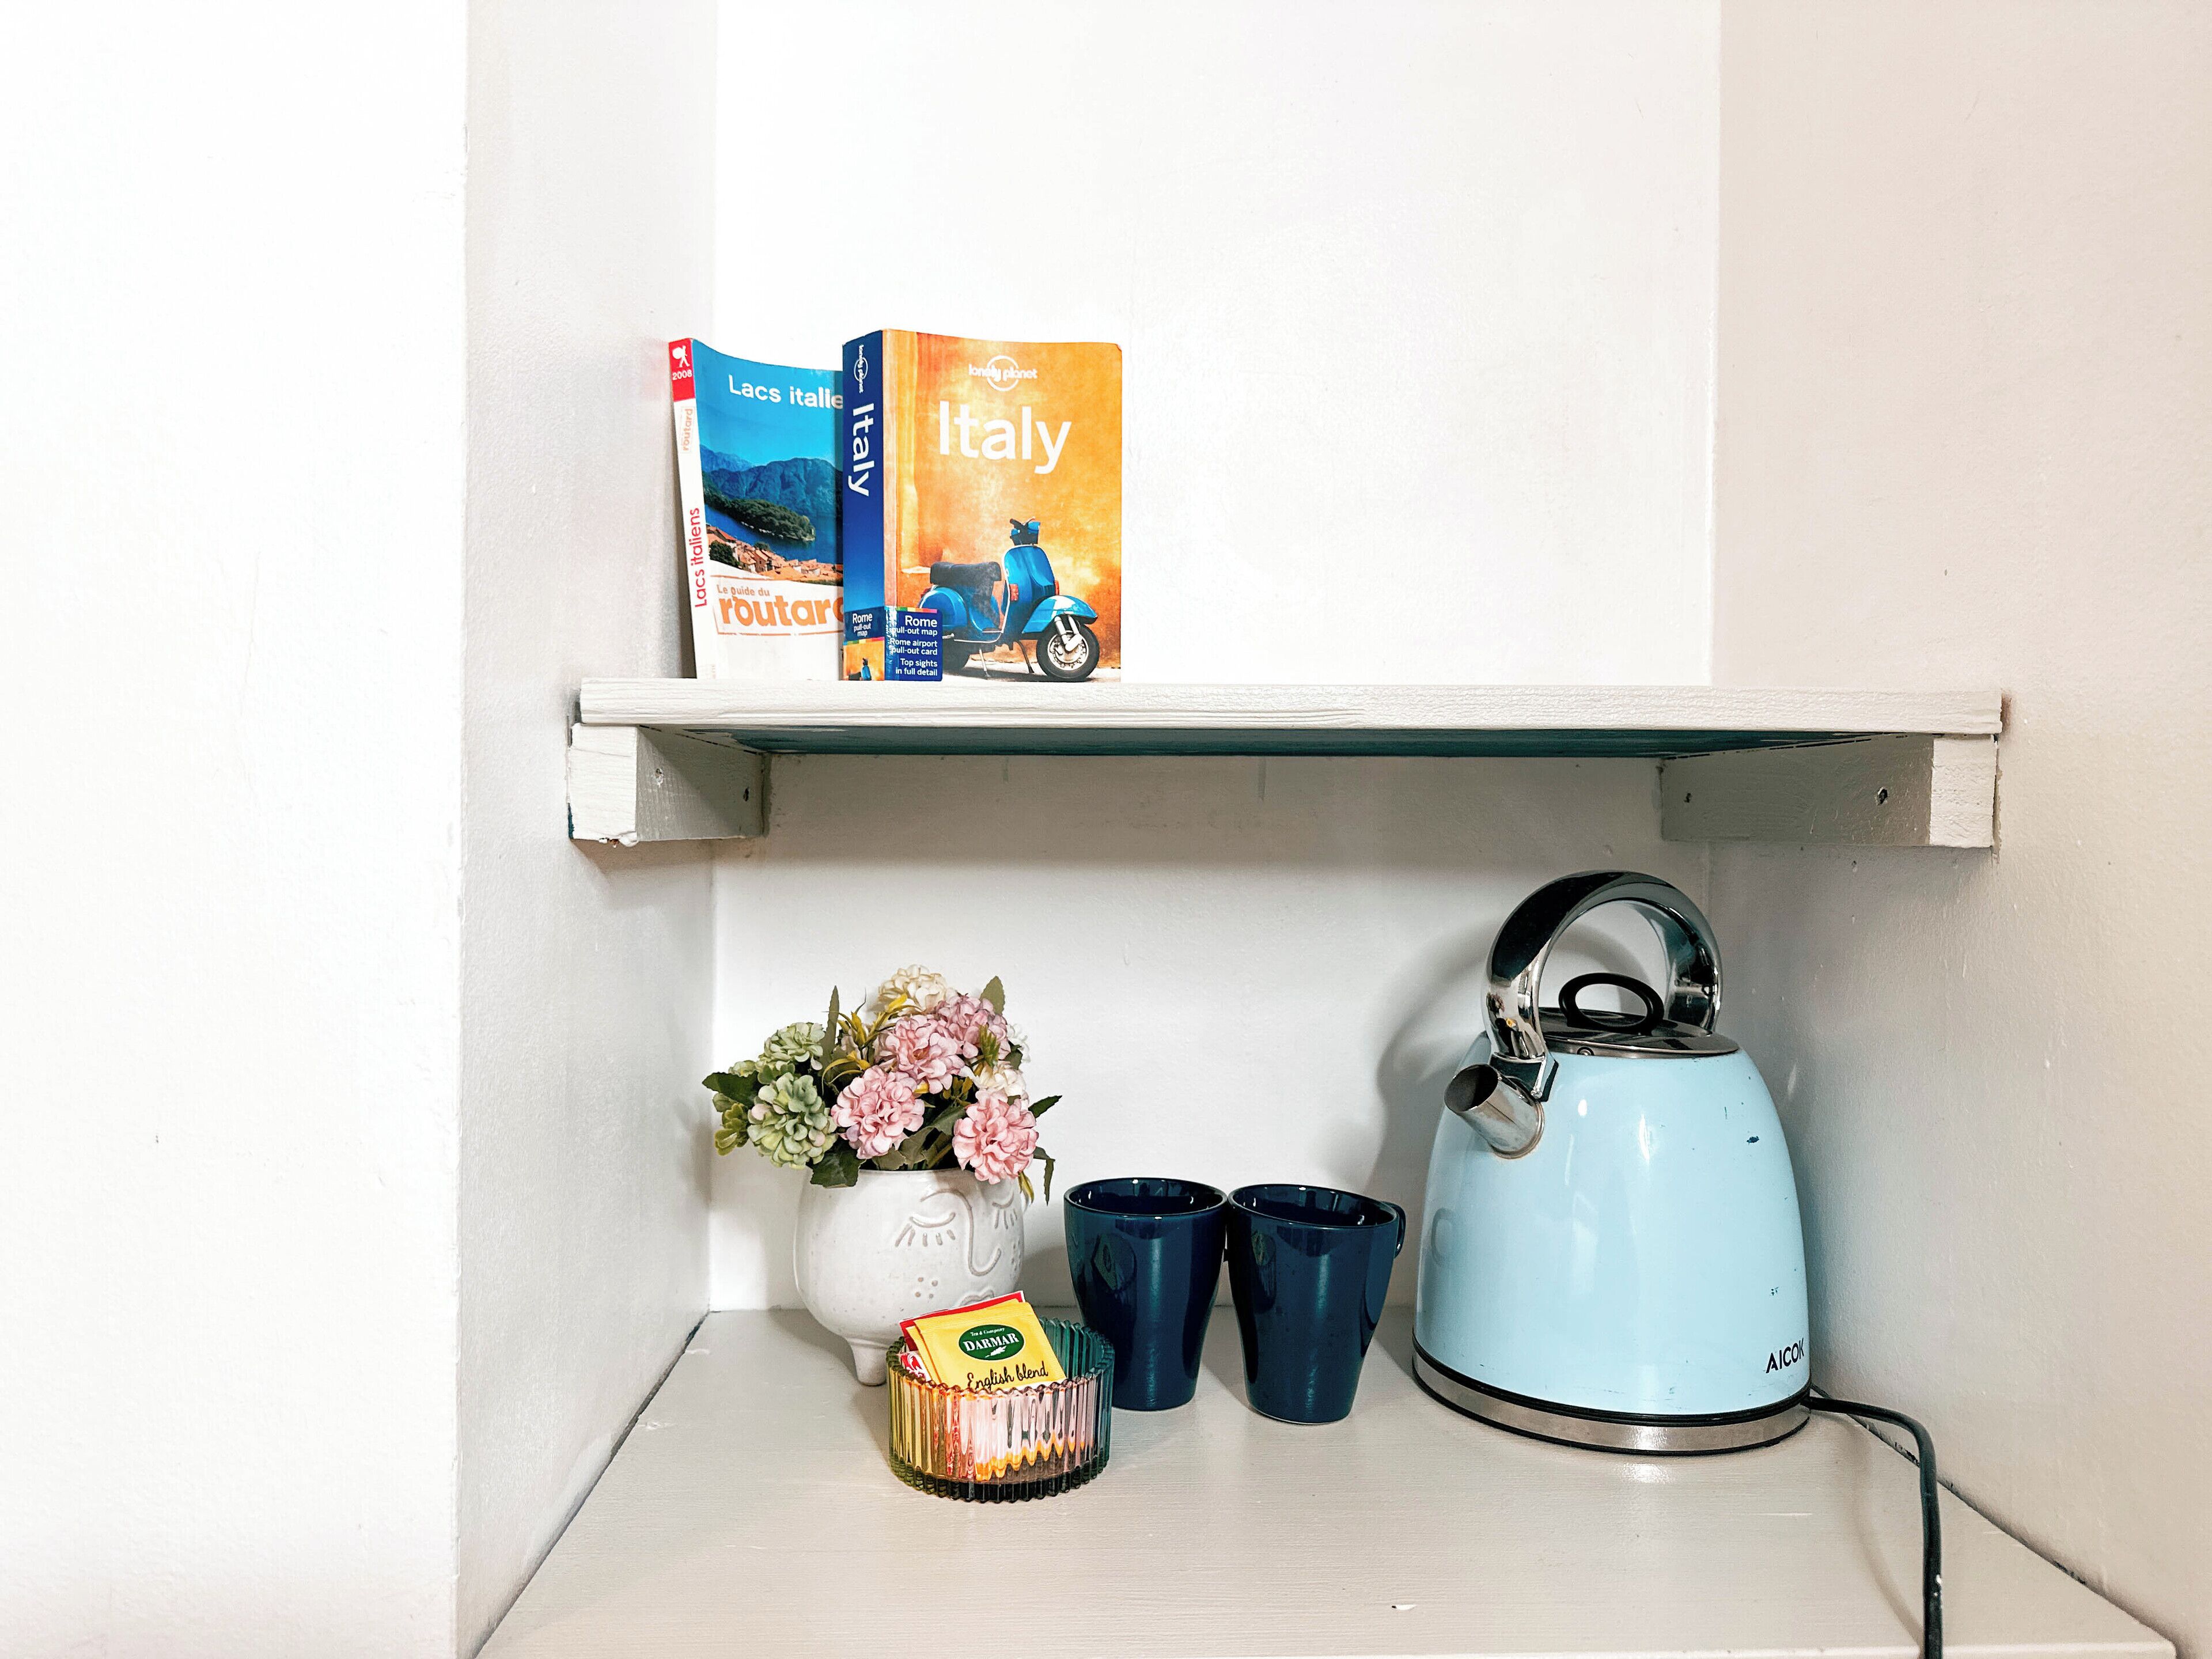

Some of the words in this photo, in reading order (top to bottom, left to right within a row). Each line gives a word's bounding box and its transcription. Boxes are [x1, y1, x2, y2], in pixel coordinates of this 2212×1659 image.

[672, 369, 693, 381] 2008
[968, 363, 1002, 382] lonely
[1002, 366, 1038, 382] planet
[728, 374, 782, 403] Lacs
[682, 408, 694, 452] routard
[939, 400, 1072, 475] Italy
[848, 403, 875, 497] Italy
[688, 507, 704, 566] italiens
[694, 569, 707, 608] Lacs
[716, 584, 728, 594] Le
[730, 585, 755, 597] guide
[758, 586, 770, 597] du
[852, 612, 873, 624] Rome
[853, 622, 872, 632] pull-out
[904, 615, 938, 627] Rome
[890, 638, 911, 646] Rome
[912, 639, 938, 647] airport
[892, 646, 920, 655] pull-out
[895, 666, 903, 675] in
[904, 667, 915, 675] full
[916, 668, 938, 676] detail
[900, 658, 914, 667] Top
[915, 659, 938, 668] sights
[963, 1332, 1020, 1351] DARMAR
[1765, 1337, 1805, 1374] AICOK
[967, 1366, 1014, 1391] English
[1015, 1360, 1049, 1381] blend
